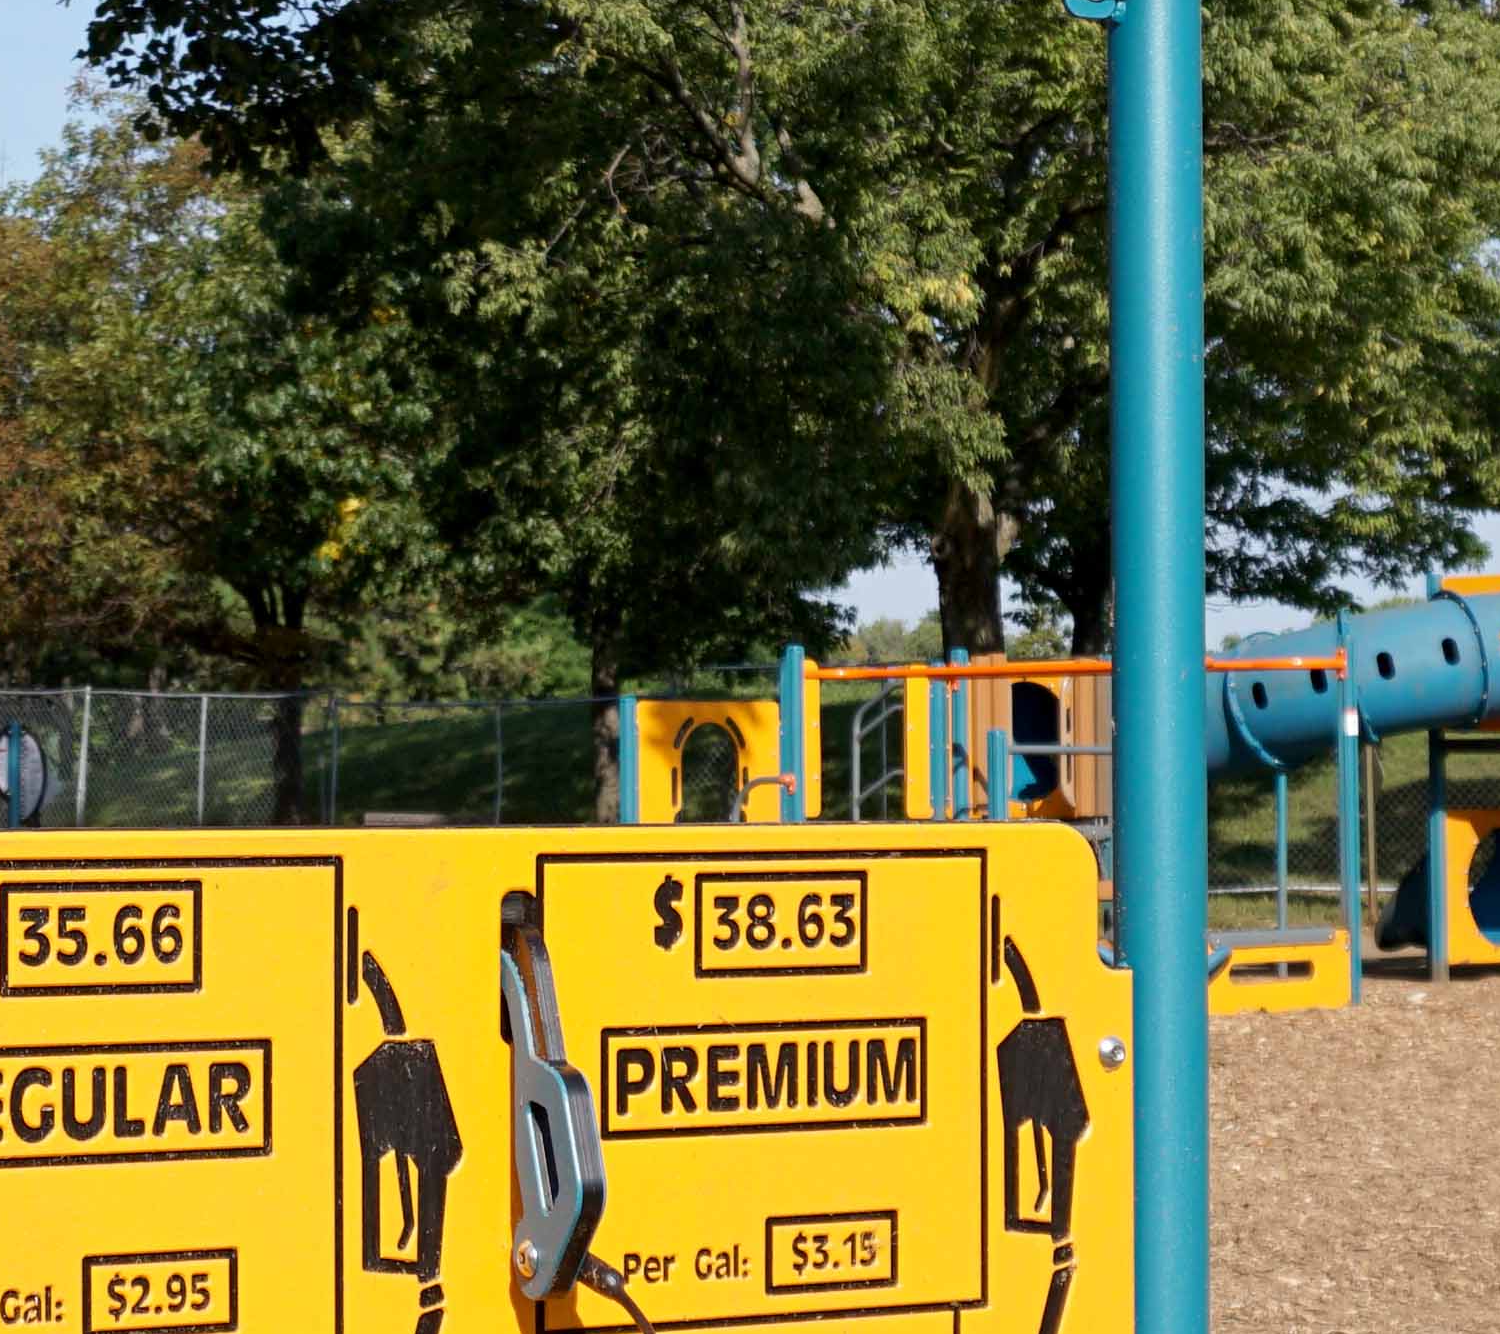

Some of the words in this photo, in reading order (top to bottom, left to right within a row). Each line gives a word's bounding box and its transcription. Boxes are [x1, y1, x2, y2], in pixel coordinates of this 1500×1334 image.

[18, 903, 183, 967] 35.66
[713, 893, 855, 951] 38.63
[614, 1037, 917, 1116] PREMIUM
[623, 1253, 675, 1284] Per
[695, 1245, 751, 1280] Gal:
[792, 1232, 876, 1275] $3.15
[0, 1286, 63, 1325] Gal:
[107, 1273, 210, 1321] $2.95
